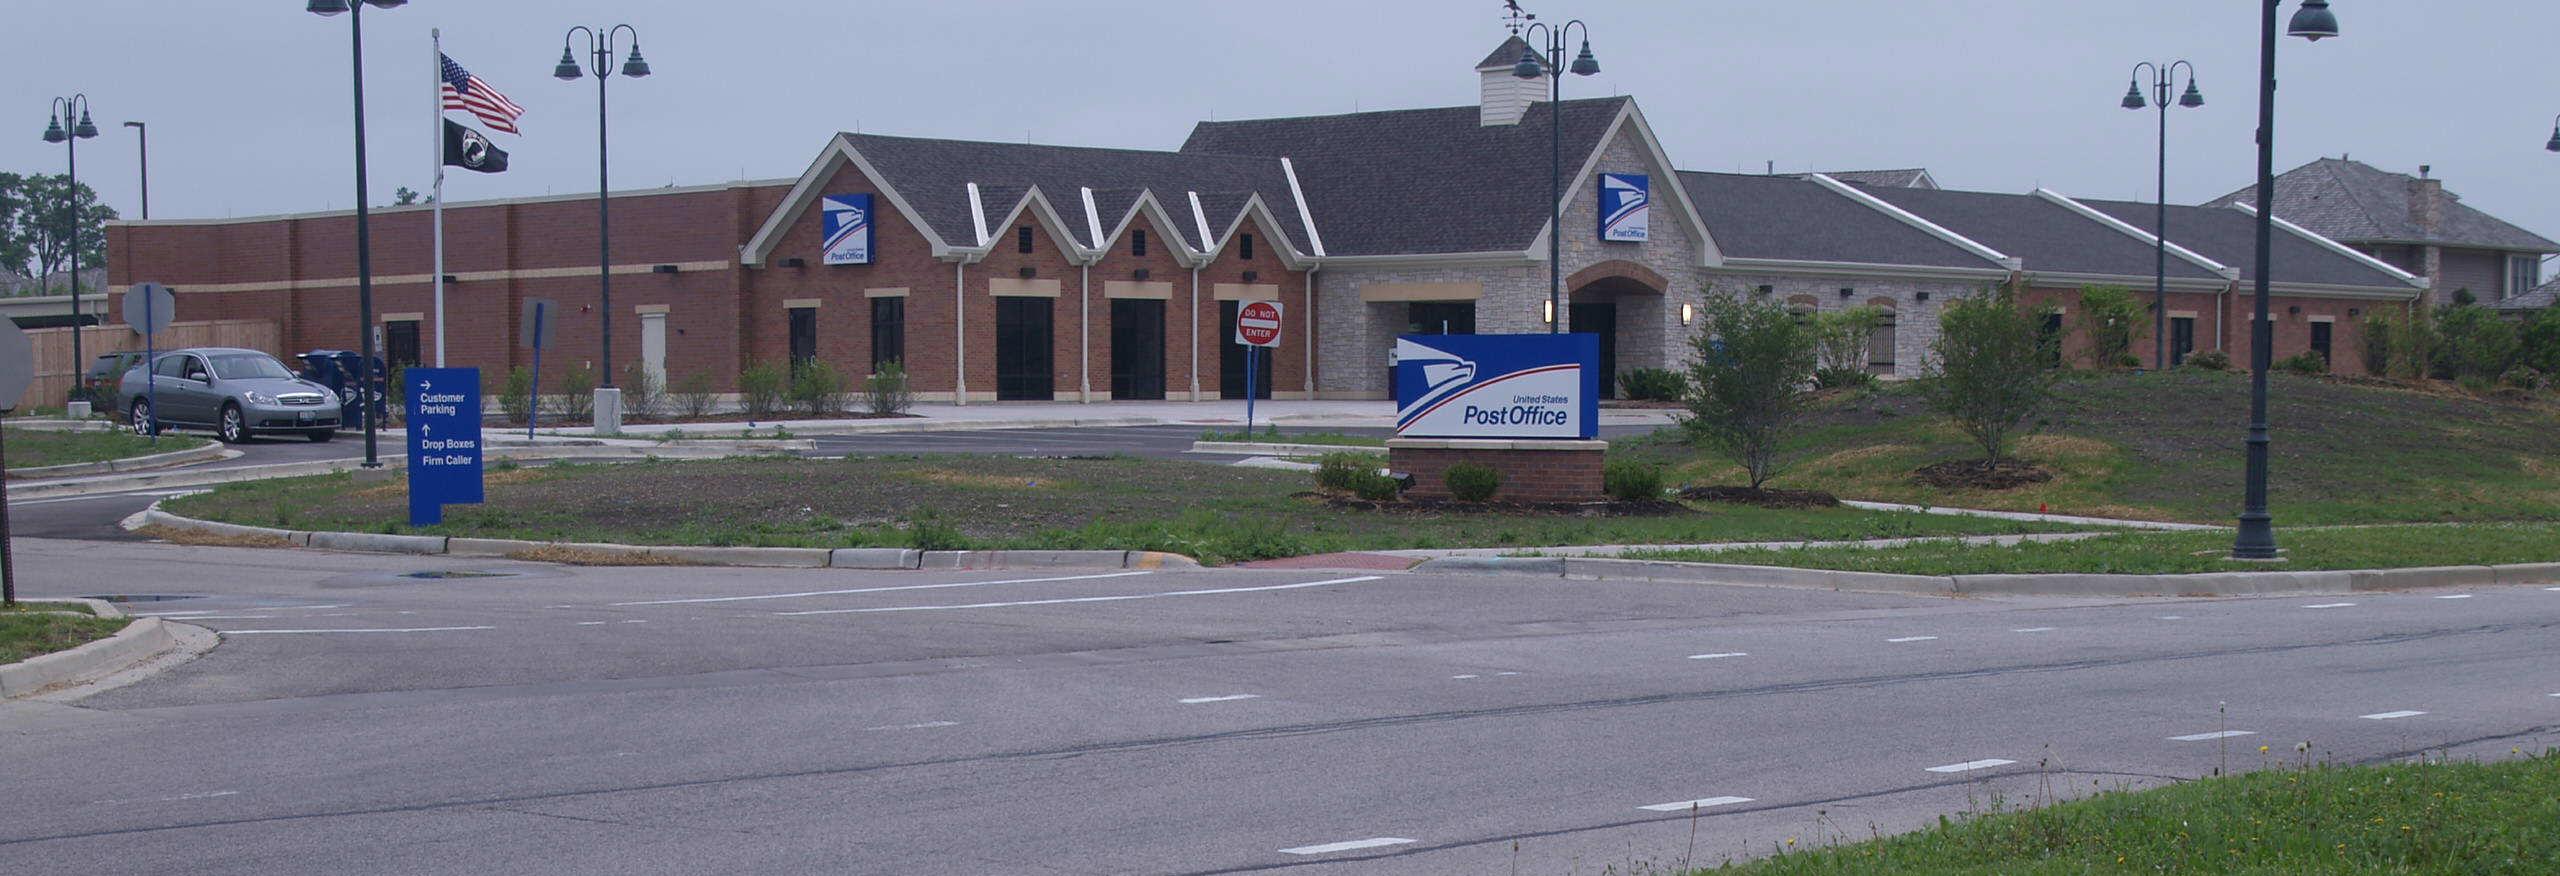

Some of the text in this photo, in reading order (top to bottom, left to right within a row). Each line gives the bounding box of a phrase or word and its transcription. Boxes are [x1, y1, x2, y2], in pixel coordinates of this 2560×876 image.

[1245, 309, 1276, 319] DO NOT
[1246, 328, 1271, 338] ENTER
[420, 393, 465, 403] Customer
[1513, 395, 1568, 404] United States
[421, 404, 456, 417] Parking
[1464, 405, 1567, 425] Post Office
[422, 439, 475, 451] Drop Boxes
[423, 455, 473, 466] Firm Caller
